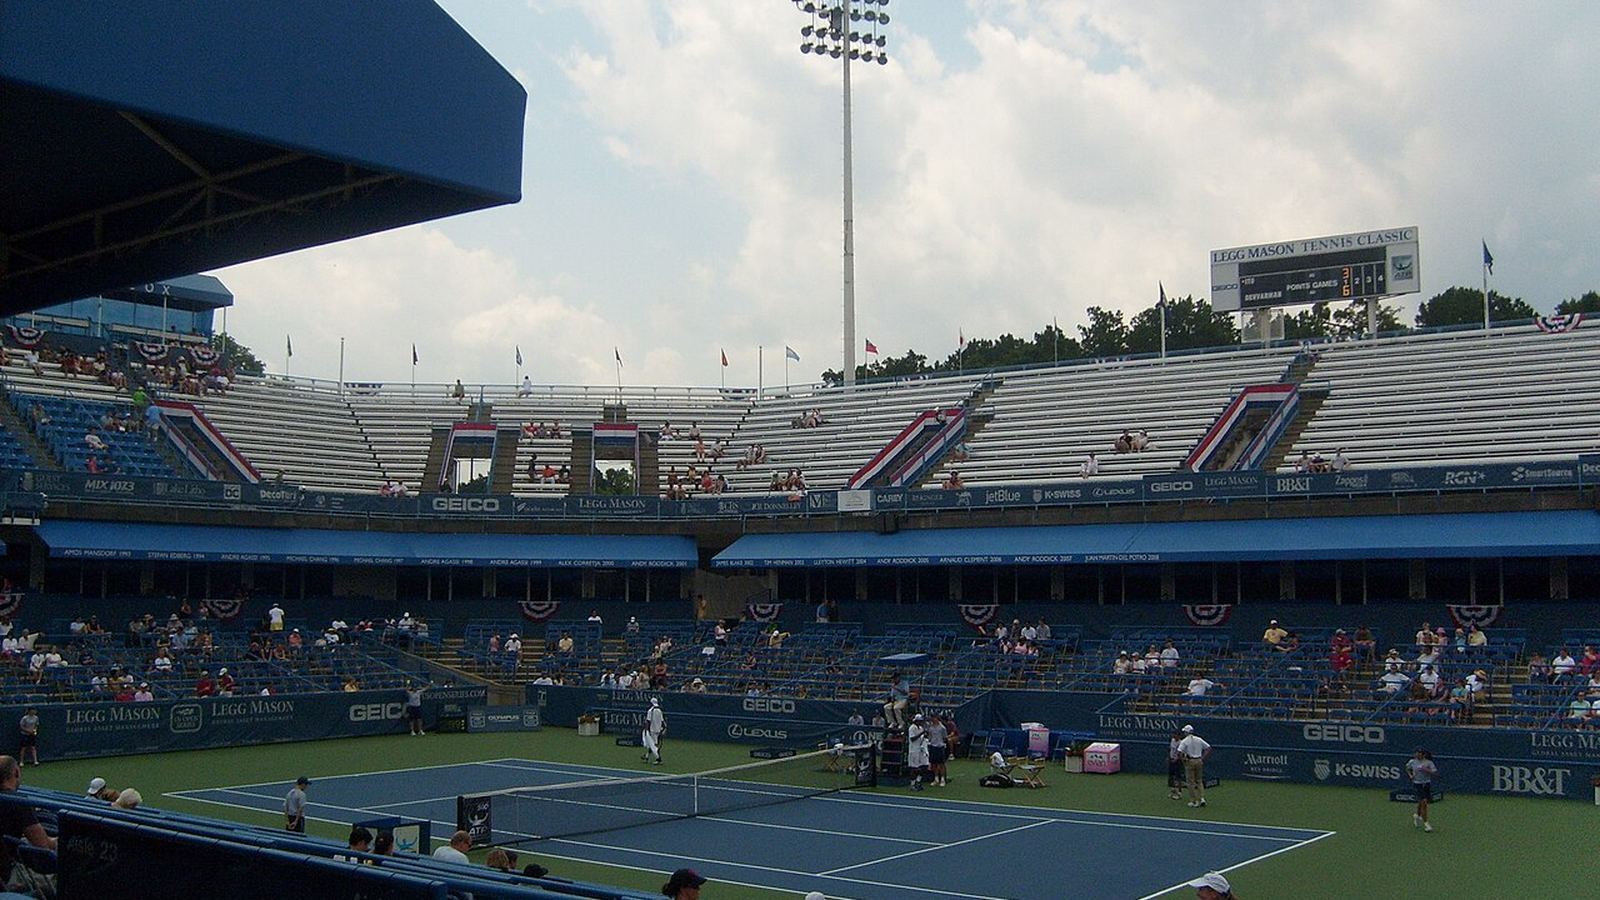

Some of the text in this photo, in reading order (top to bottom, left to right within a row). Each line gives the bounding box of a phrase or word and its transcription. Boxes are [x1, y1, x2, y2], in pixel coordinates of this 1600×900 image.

[1213, 230, 1413, 263] LEGG MASON TENNIS CLASSIC
[1286, 280, 1338, 292] POINTS GAMES
[1354, 277, 1360, 285] 2
[1525, 468, 1572, 478] SmartSource
[85, 480, 109, 490] MIX
[1151, 481, 1193, 492] GEICO
[1205, 476, 1258, 487] LEGG MASON
[1277, 477, 1313, 492] BB&T
[877, 493, 903, 502] CAREY
[986, 489, 1021, 504] jetBlue
[432, 498, 500, 511] GEICO
[579, 498, 646, 509] LEGG MASON
[612, 690, 634, 701] LEGG
[211, 700, 294, 716] LEGG MASON
[743, 698, 795, 713] GEICO
[66, 707, 160, 724] LEGG MASON
[604, 712, 630, 725] LEGG
[1100, 714, 1179, 731] LEGG MASON
[744, 727, 788, 739] LEXUS
[1303, 724, 1384, 743] GEICO
[1531, 732, 1573, 748] LEGG
[1244, 754, 1288, 765] Marriott
[1491, 765, 1571, 795] BB&T
[469, 825, 488, 835] ATP
[100, 840, 118, 862] 23
